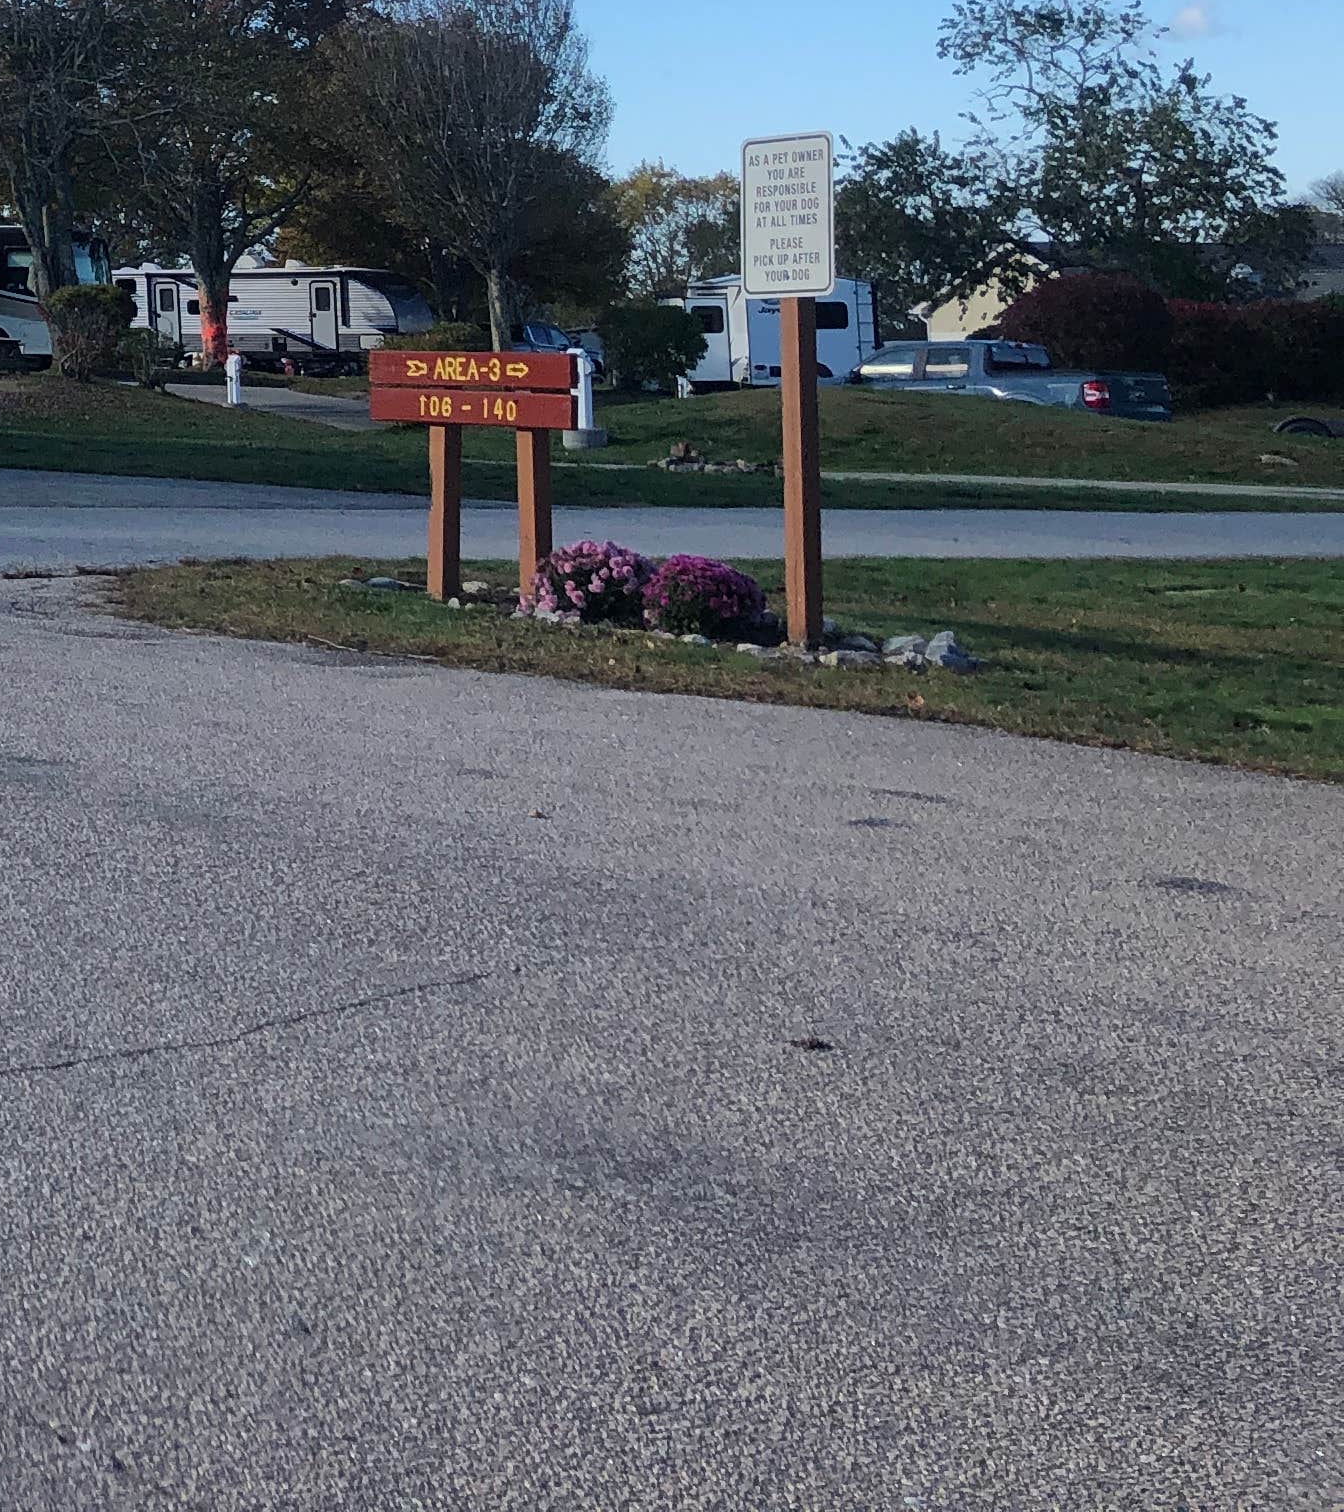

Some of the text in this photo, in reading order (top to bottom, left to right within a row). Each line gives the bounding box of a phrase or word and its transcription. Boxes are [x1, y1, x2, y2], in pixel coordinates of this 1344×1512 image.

[749, 149, 824, 167] AS A PET OWNER
[767, 167, 805, 180] YOU ARE
[756, 182, 816, 197] RESPONSIBLE
[754, 197, 819, 213] FOR YOUR DOG
[756, 213, 818, 227] AT ALL TIMES
[770, 236, 804, 250] PLEASE
[753, 252, 820, 266] PICK UP AFTER
[765, 268, 810, 282] YOUR DOG
[433, 357, 501, 382] AREA-3
[482, 397, 517, 421] 140
